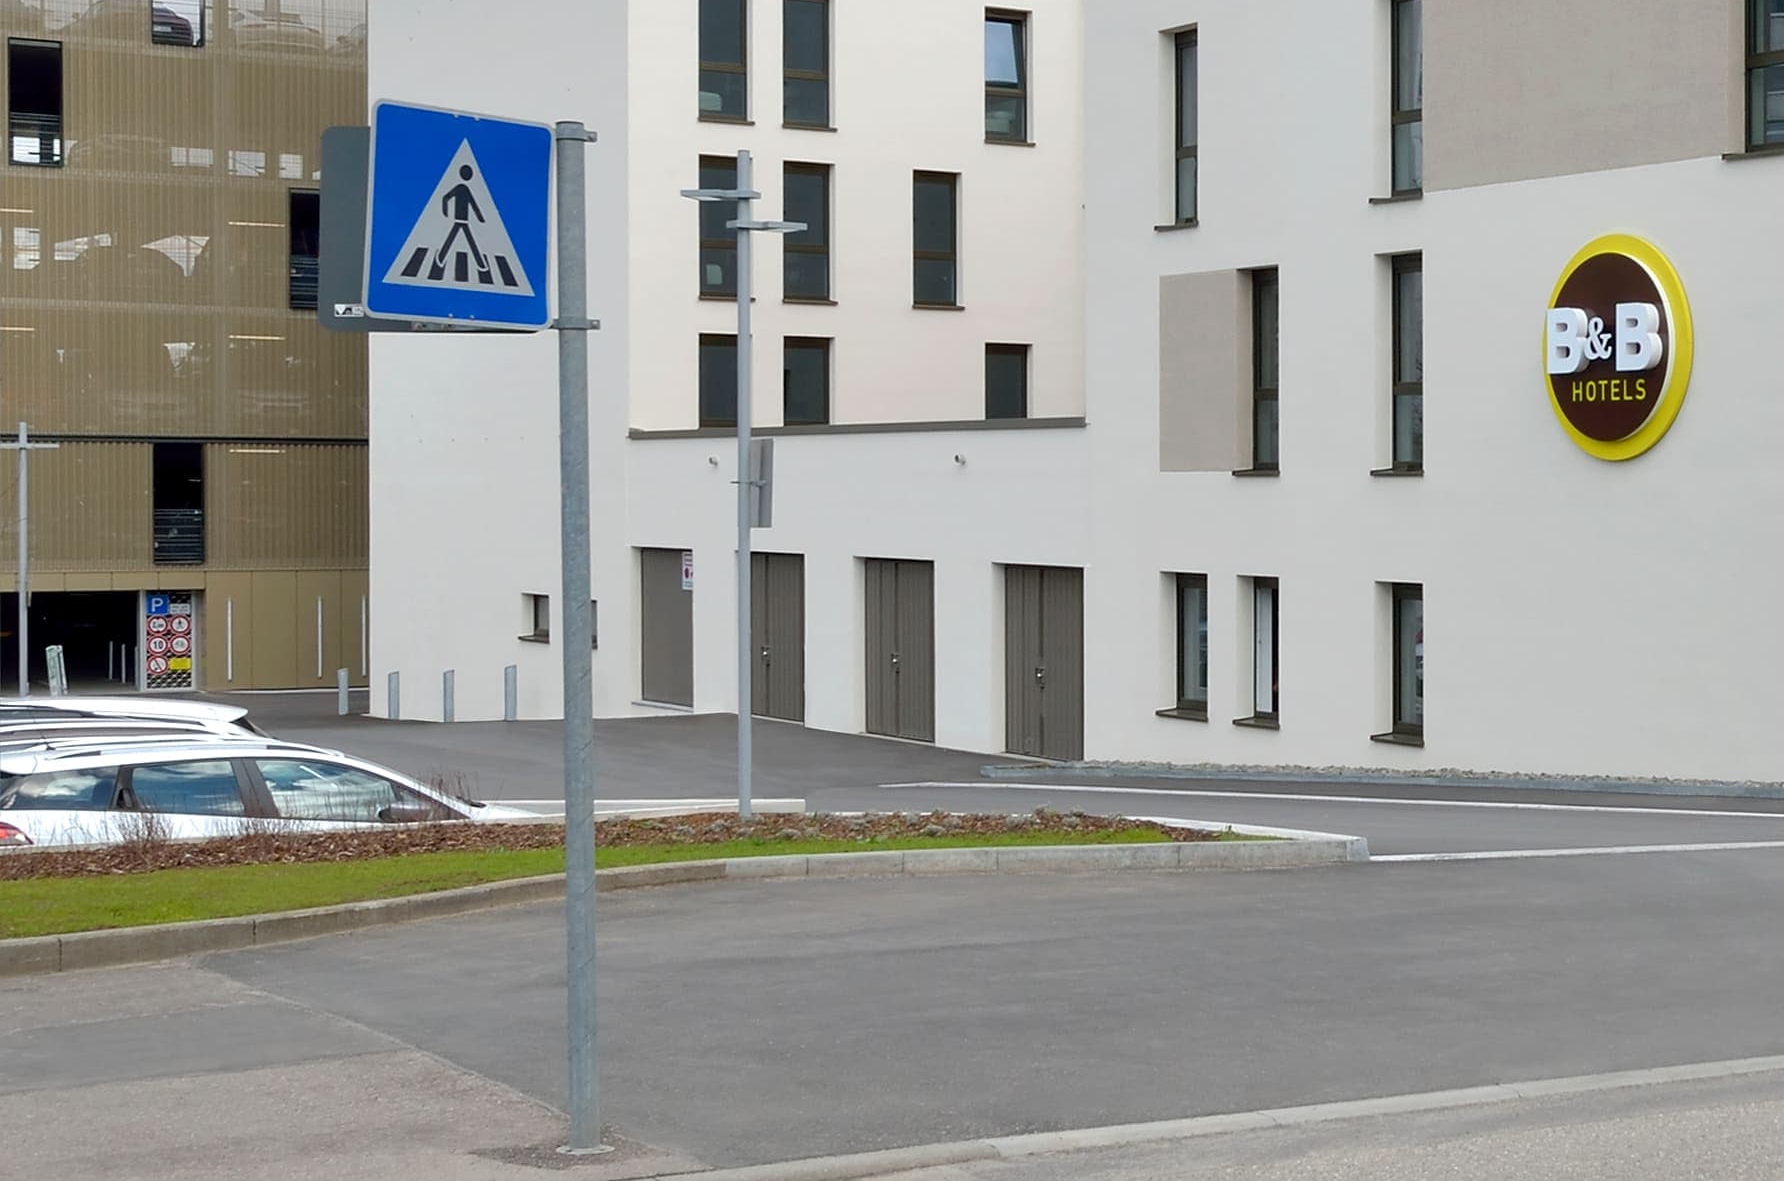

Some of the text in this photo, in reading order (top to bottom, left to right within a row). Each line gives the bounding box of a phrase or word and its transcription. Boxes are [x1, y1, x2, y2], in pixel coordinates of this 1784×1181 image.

[1546, 302, 1662, 375] B&B
[1572, 379, 1647, 402] HOTELS
[151, 597, 164, 613] P
[153, 640, 164, 650] 10
